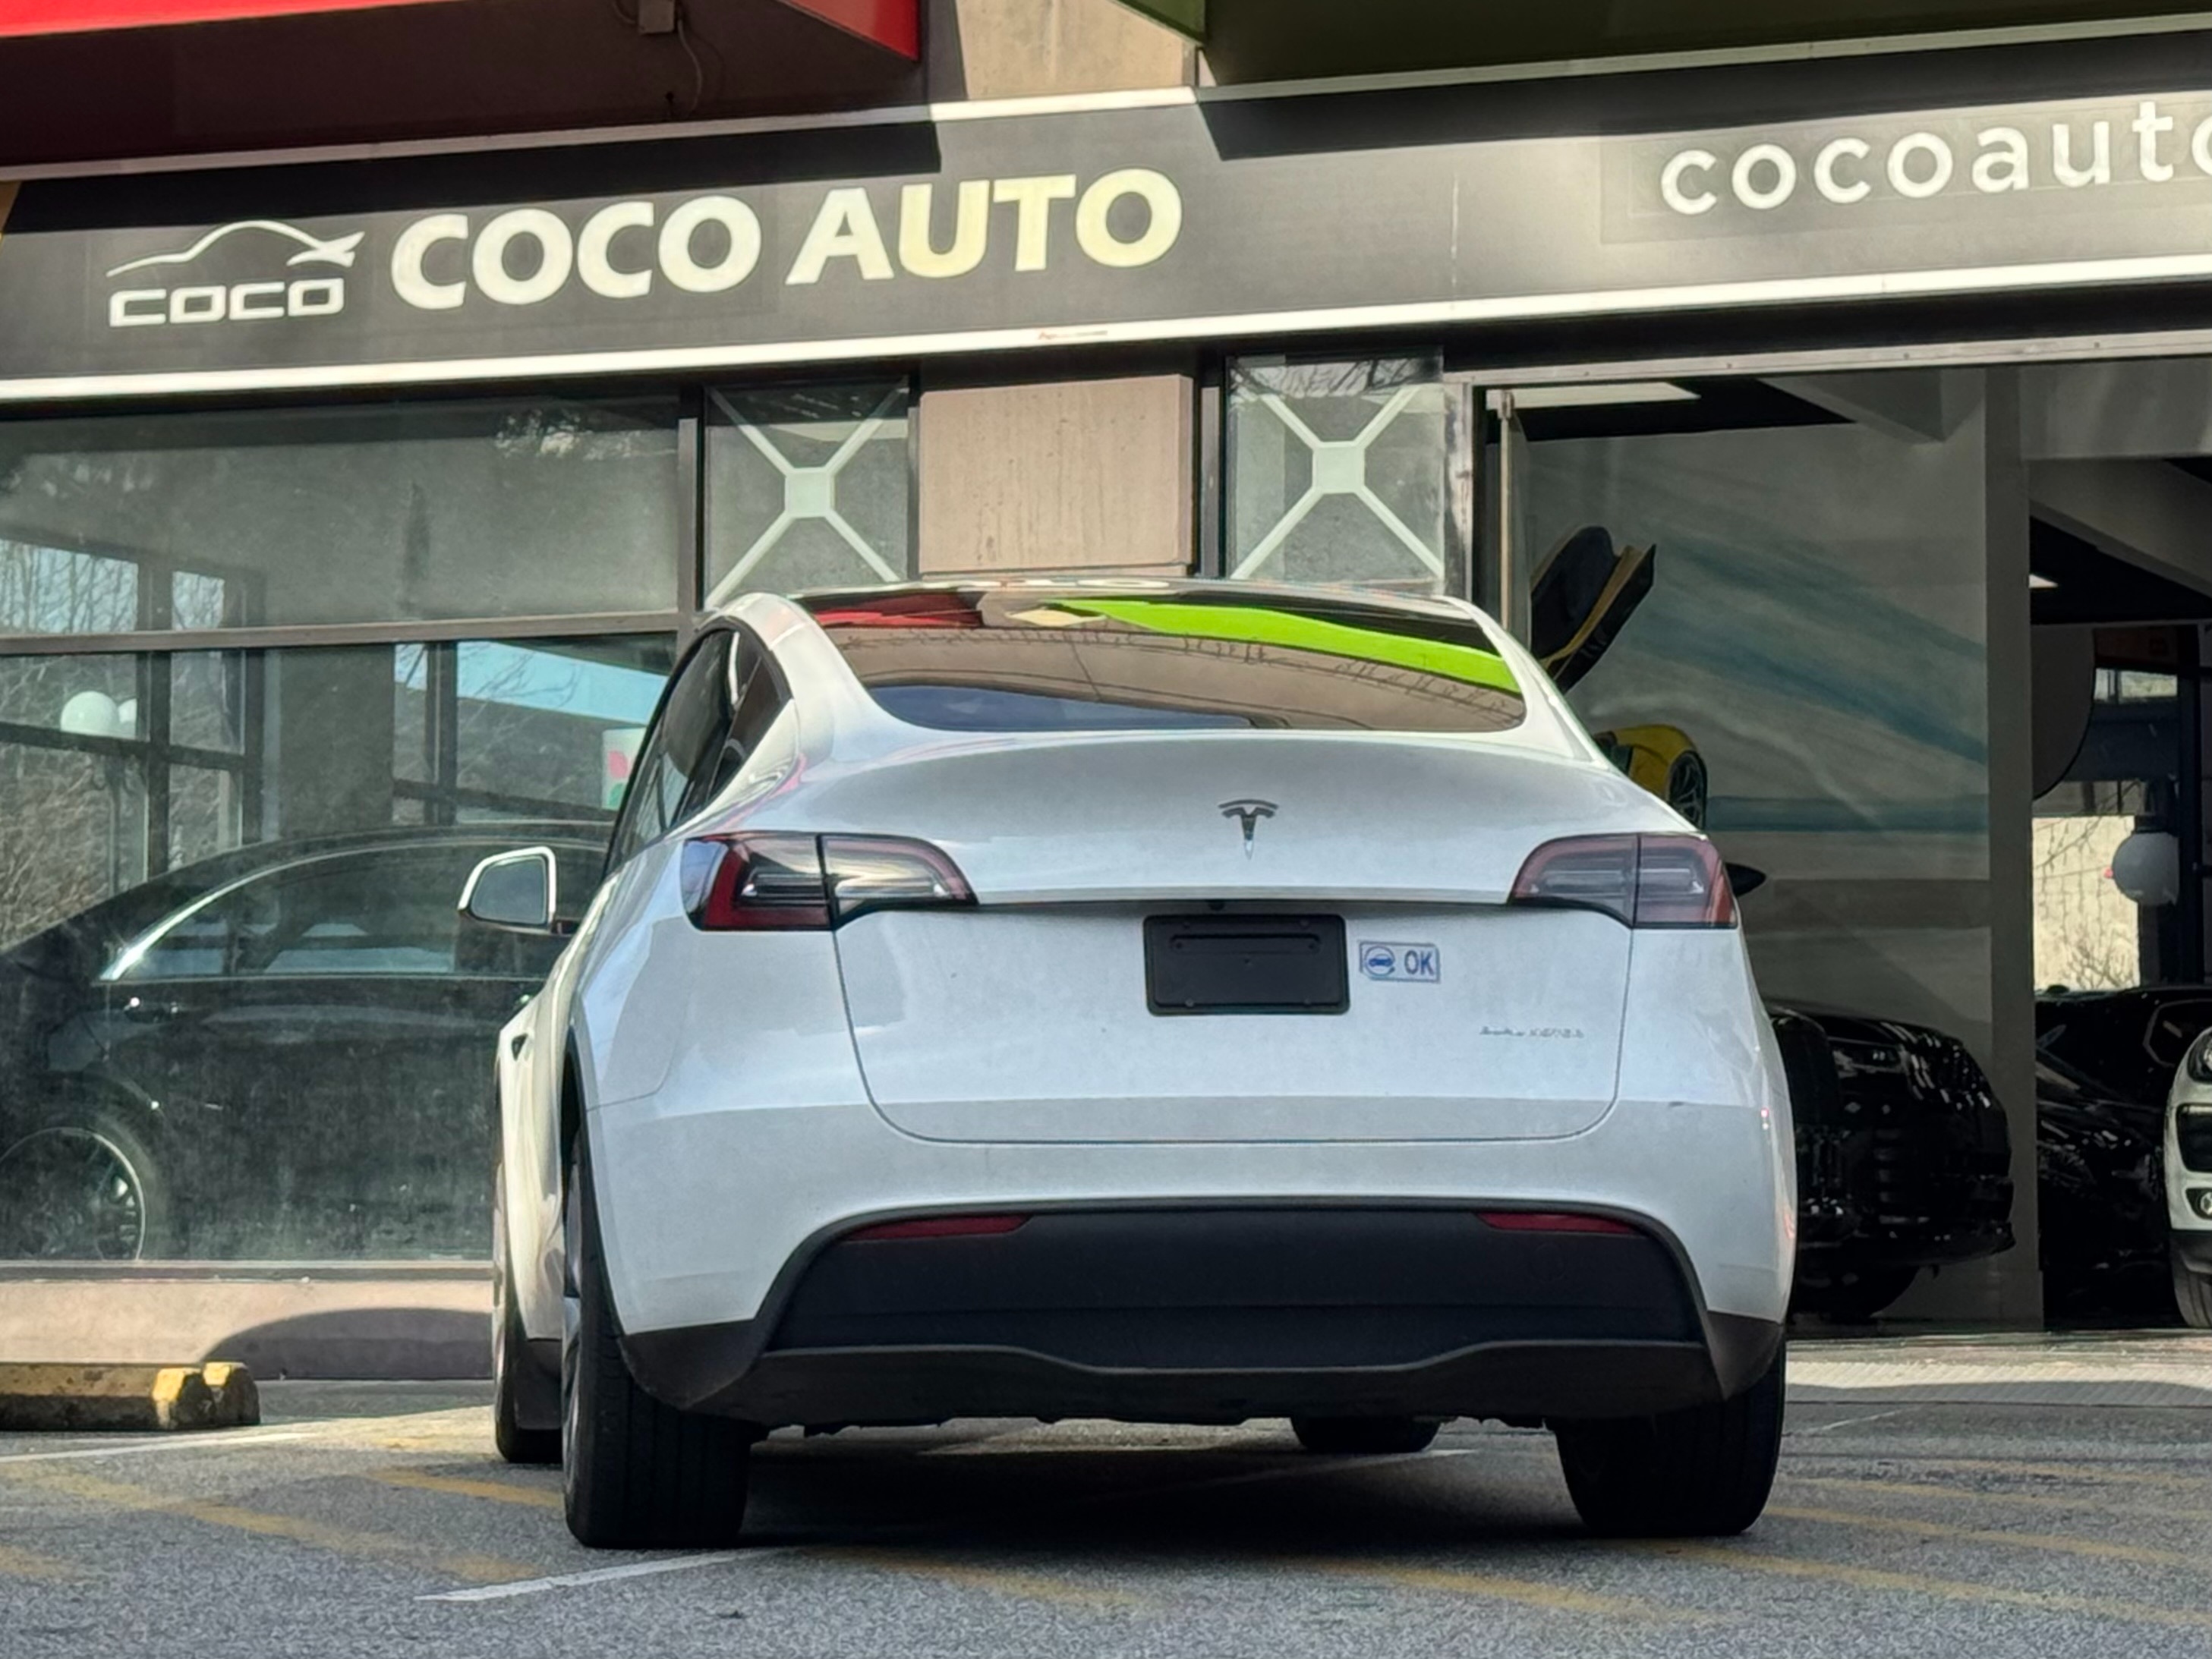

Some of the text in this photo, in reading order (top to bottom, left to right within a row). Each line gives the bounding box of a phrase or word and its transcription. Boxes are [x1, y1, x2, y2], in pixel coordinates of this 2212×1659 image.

[391, 168, 1182, 310] COCO AUTO
[109, 278, 344, 327] COCO
[1404, 949, 1435, 976] OK
